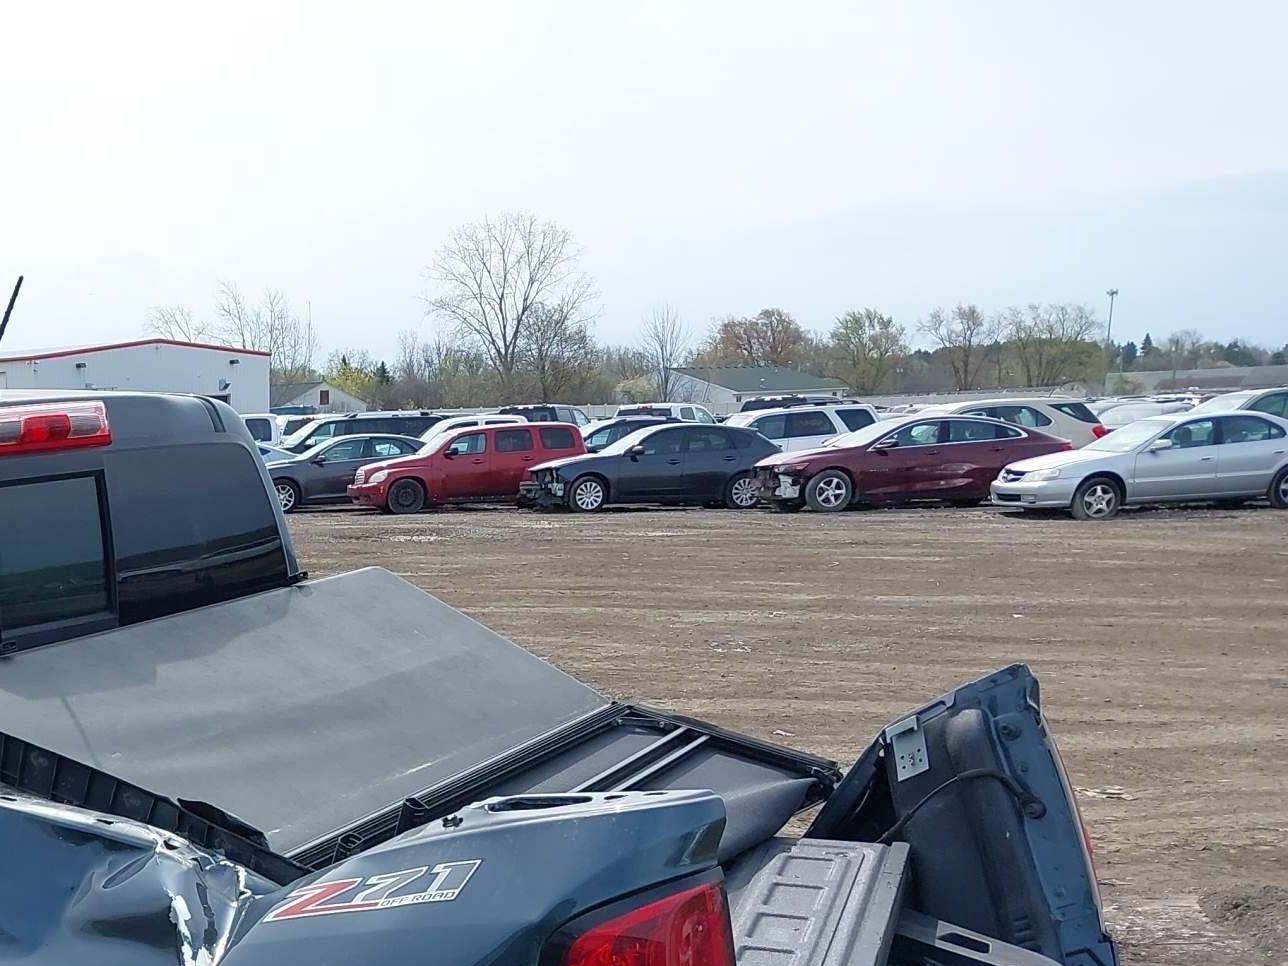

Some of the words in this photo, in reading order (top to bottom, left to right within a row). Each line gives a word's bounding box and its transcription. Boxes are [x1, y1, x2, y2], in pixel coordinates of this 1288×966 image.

[262, 859, 483, 922] Z71
[379, 896, 409, 907] OFF
[411, 891, 456, 902] ROAD
